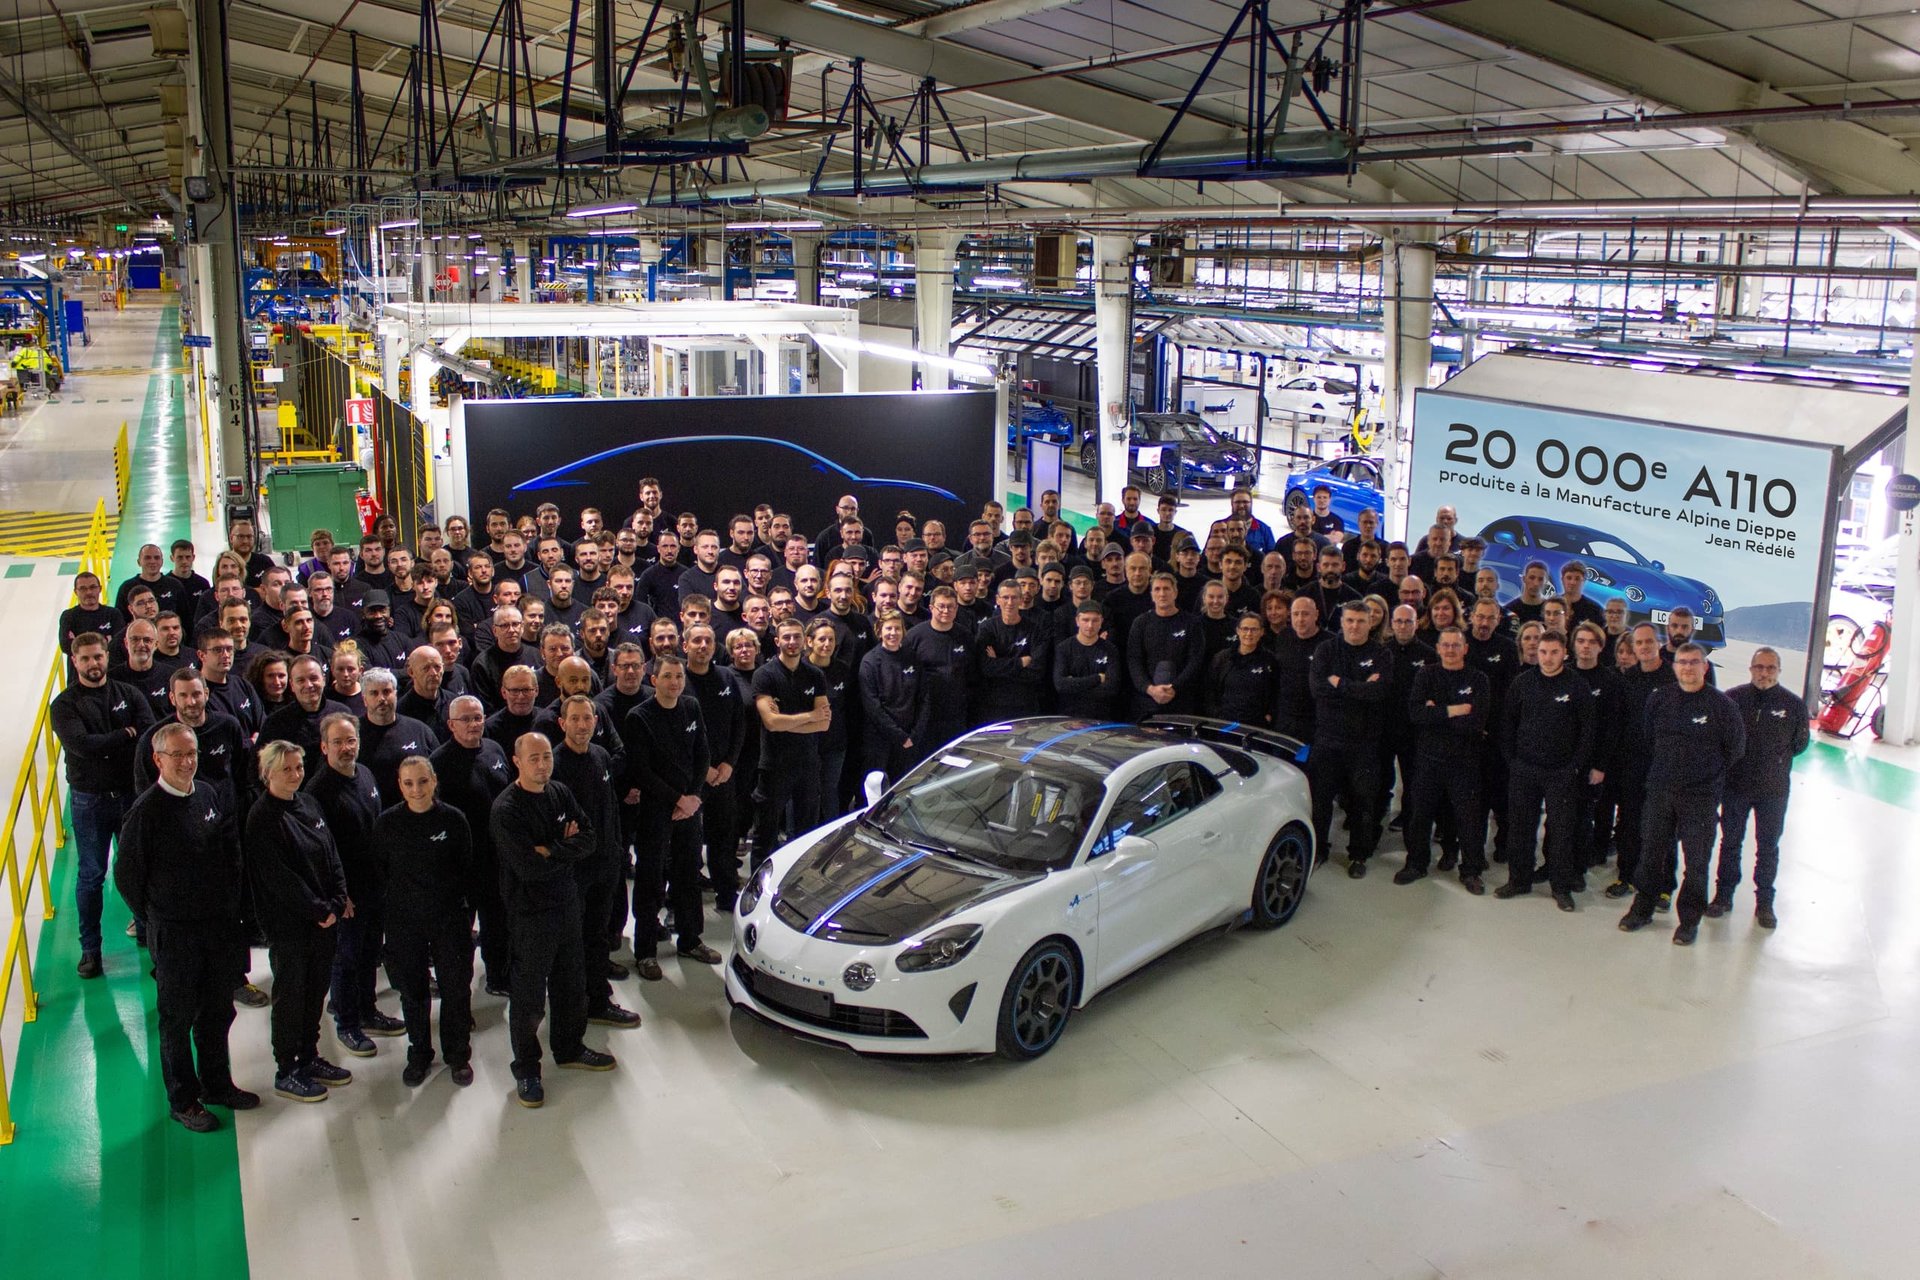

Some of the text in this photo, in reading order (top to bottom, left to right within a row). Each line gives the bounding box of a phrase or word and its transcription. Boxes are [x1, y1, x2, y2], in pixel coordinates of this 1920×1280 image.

[436, 279, 451, 287] STOP
[1445, 423, 1516, 470] 20
[1682, 465, 1797, 519] A110
[1439, 470, 1797, 542] produite à la Manufacture Alpine Dieppe
[1705, 533, 1796, 560] Jean Rédélé
[1657, 612, 1667, 623] LC
[760, 959, 826, 986] ALPINE
